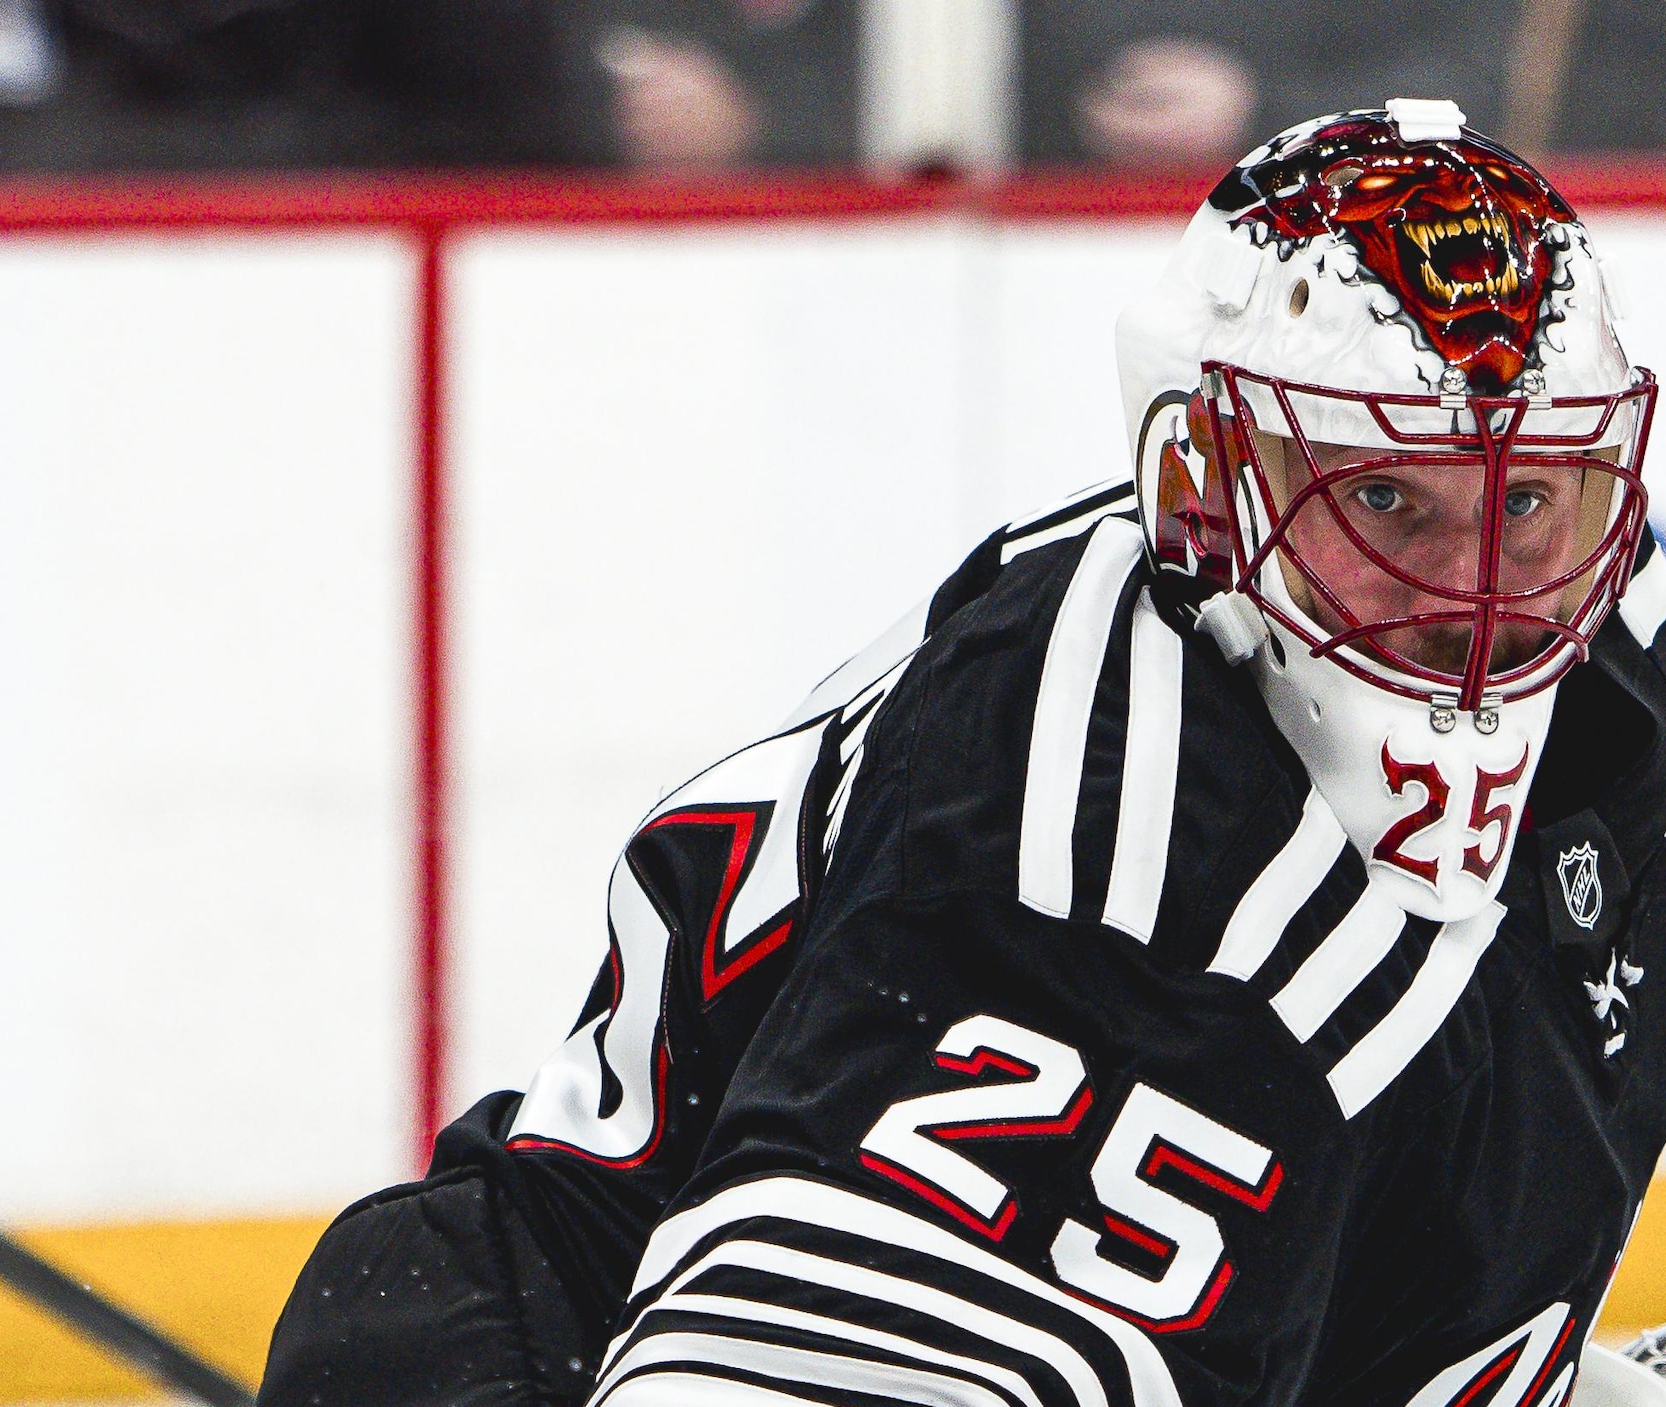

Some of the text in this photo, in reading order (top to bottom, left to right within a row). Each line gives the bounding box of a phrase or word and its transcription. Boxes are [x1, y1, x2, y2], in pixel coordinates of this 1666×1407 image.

[1372, 735, 1530, 888] 25
[1572, 866, 1593, 914] NHL
[859, 1013, 1283, 1333] 25
